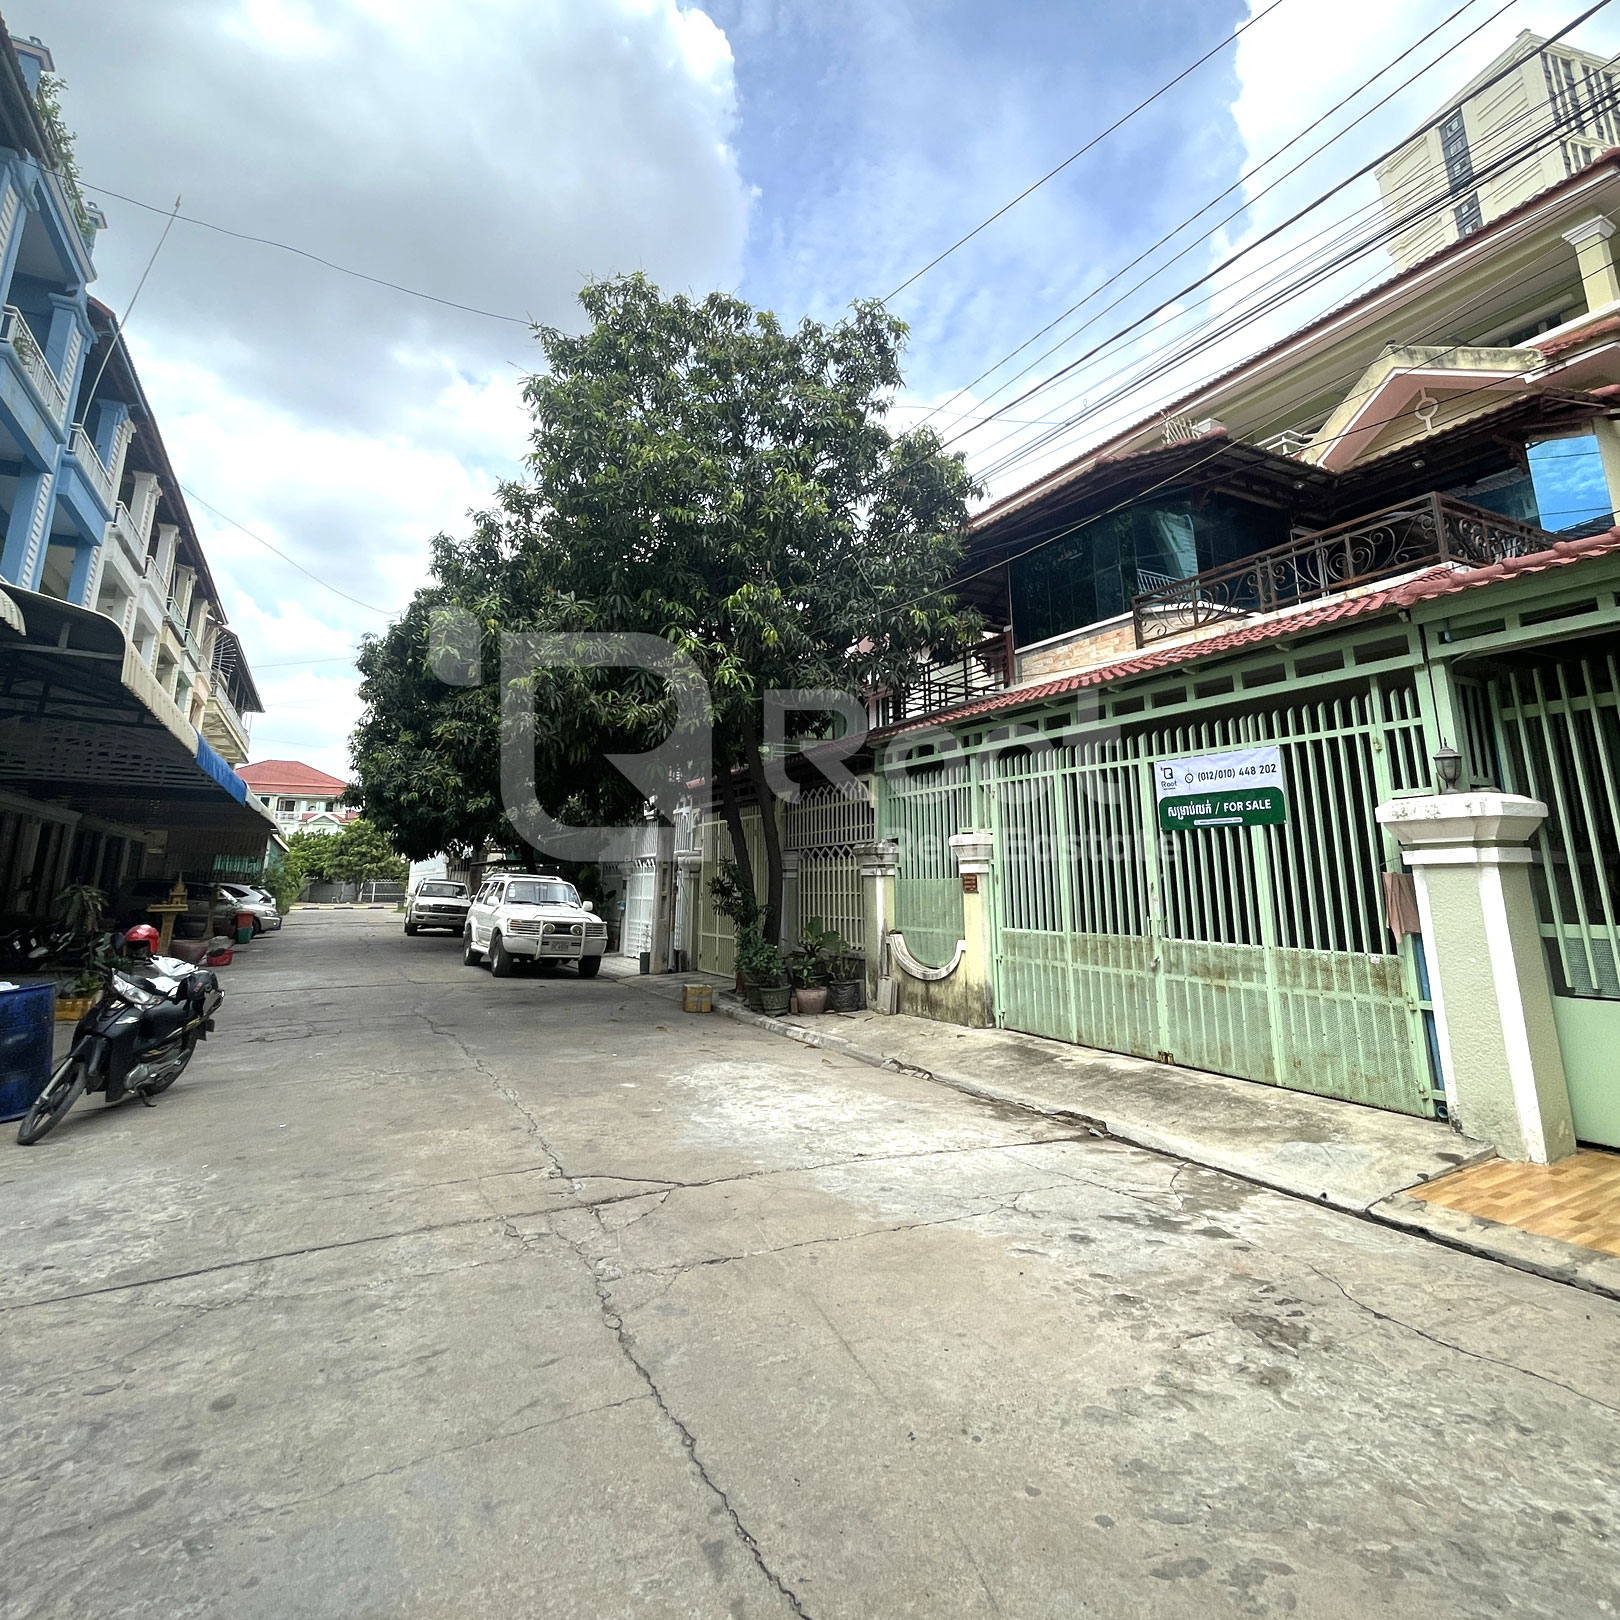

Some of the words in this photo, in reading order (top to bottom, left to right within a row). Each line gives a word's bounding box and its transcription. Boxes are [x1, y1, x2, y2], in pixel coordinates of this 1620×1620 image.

[1198, 769, 1235, 782] (012/010)
[1239, 766, 1256, 776] 448
[1259, 764, 1276, 774] 202
[1224, 802, 1243, 812] FOR
[1246, 800, 1271, 811] SALE
